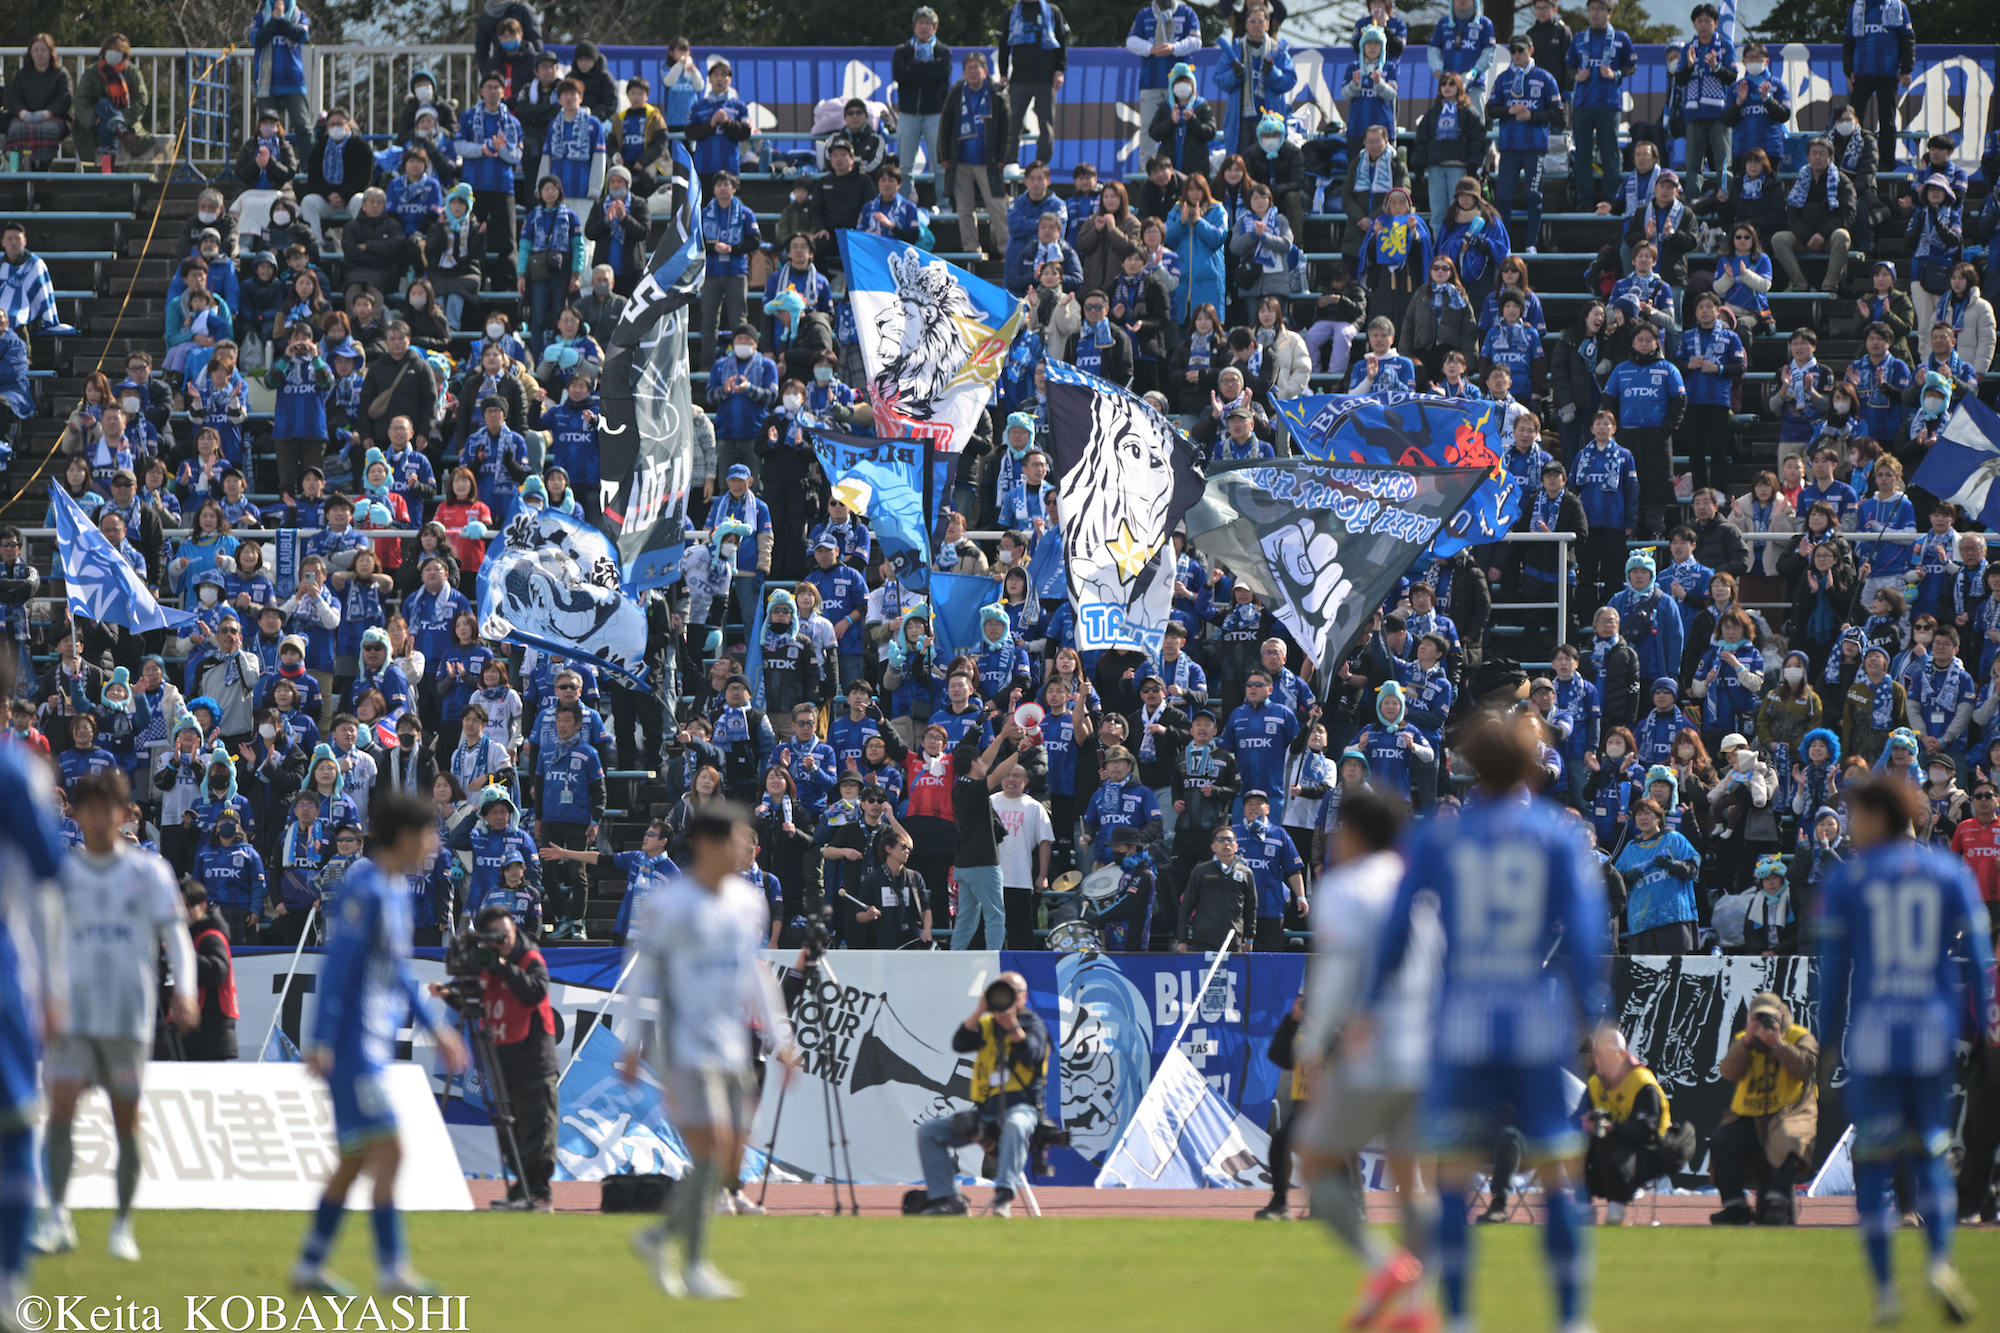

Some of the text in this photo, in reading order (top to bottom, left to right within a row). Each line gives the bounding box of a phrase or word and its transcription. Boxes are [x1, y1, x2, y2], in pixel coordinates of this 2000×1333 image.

[1513, 100, 1537, 109] TDK
[404, 204, 427, 214] TDK
[971, 337, 1006, 365] 12
[1501, 353, 1526, 362] TDK
[293, 384, 316, 393] TDK
[1632, 388, 1659, 397] TDK
[568, 433, 591, 442] TDK
[1229, 630, 1257, 641] TDK
[768, 659, 796, 670] TDK
[1408, 694, 1430, 712] TDK
[1044, 741, 1069, 752] TDK
[1245, 738, 1272, 748] TDK
[1378, 748, 1404, 759] TDK
[1191, 755, 1202, 770] 17
[551, 772, 579, 782] TDK
[919, 776, 944, 787] TDK
[1106, 814, 1131, 824] TDK
[1246, 858, 1270, 869] TDK
[211, 868, 240, 879] TDK
[1644, 869, 1671, 884] TDK
[1450, 838, 1549, 949] 19
[1864, 879, 1943, 970] 10
[1190, 1043, 1208, 1054] TAS
